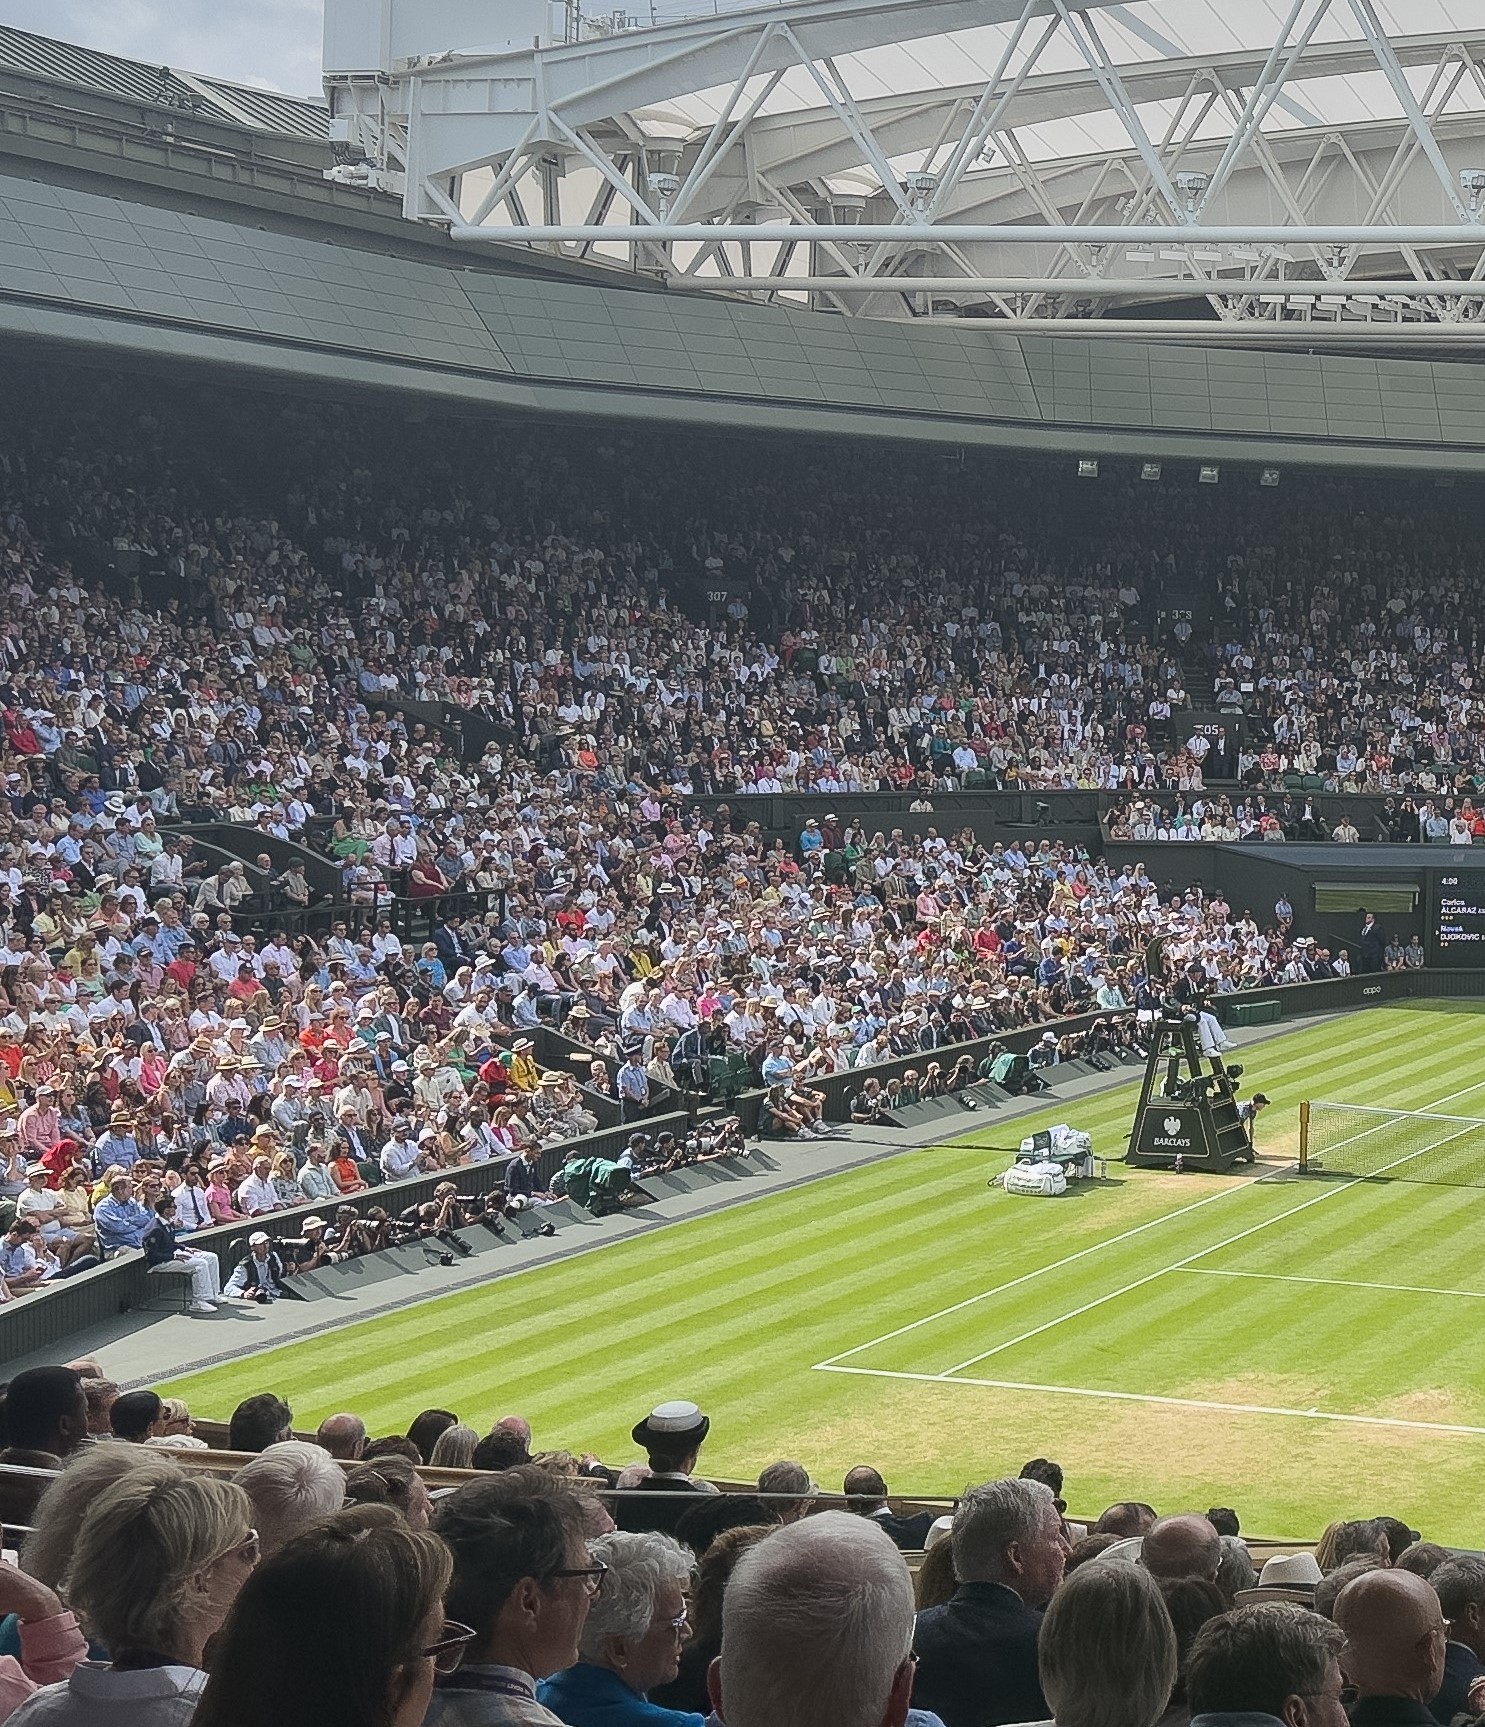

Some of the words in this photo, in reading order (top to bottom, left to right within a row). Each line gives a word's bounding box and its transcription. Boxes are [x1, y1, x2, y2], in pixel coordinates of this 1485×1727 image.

[706, 590, 728, 602] 307
[1440, 906, 1477, 914] ALCARAZ
[1362, 985, 1382, 996] oppo
[1153, 1137, 1191, 1147] BARCLAYS
